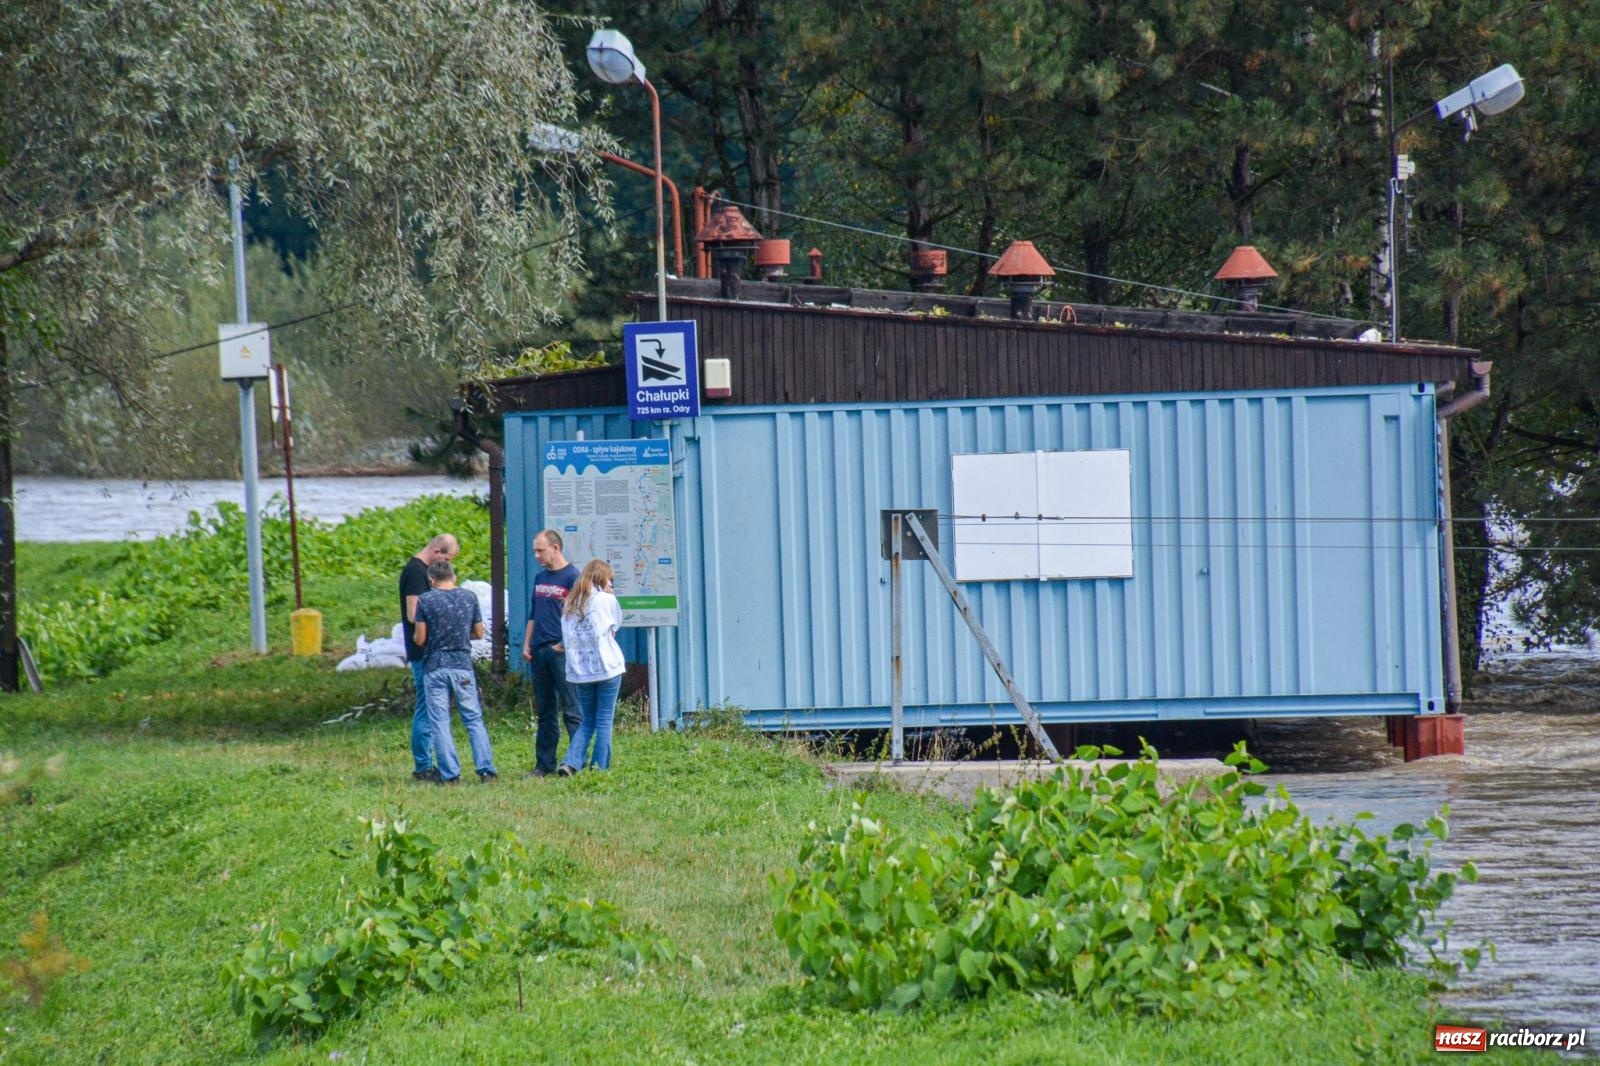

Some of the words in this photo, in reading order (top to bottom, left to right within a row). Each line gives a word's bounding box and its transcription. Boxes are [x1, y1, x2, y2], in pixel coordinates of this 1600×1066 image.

[636, 388, 690, 403] Chałupki
[636, 406, 650, 415] 725
[650, 406, 662, 414] km
[672, 405, 691, 414] Odry
